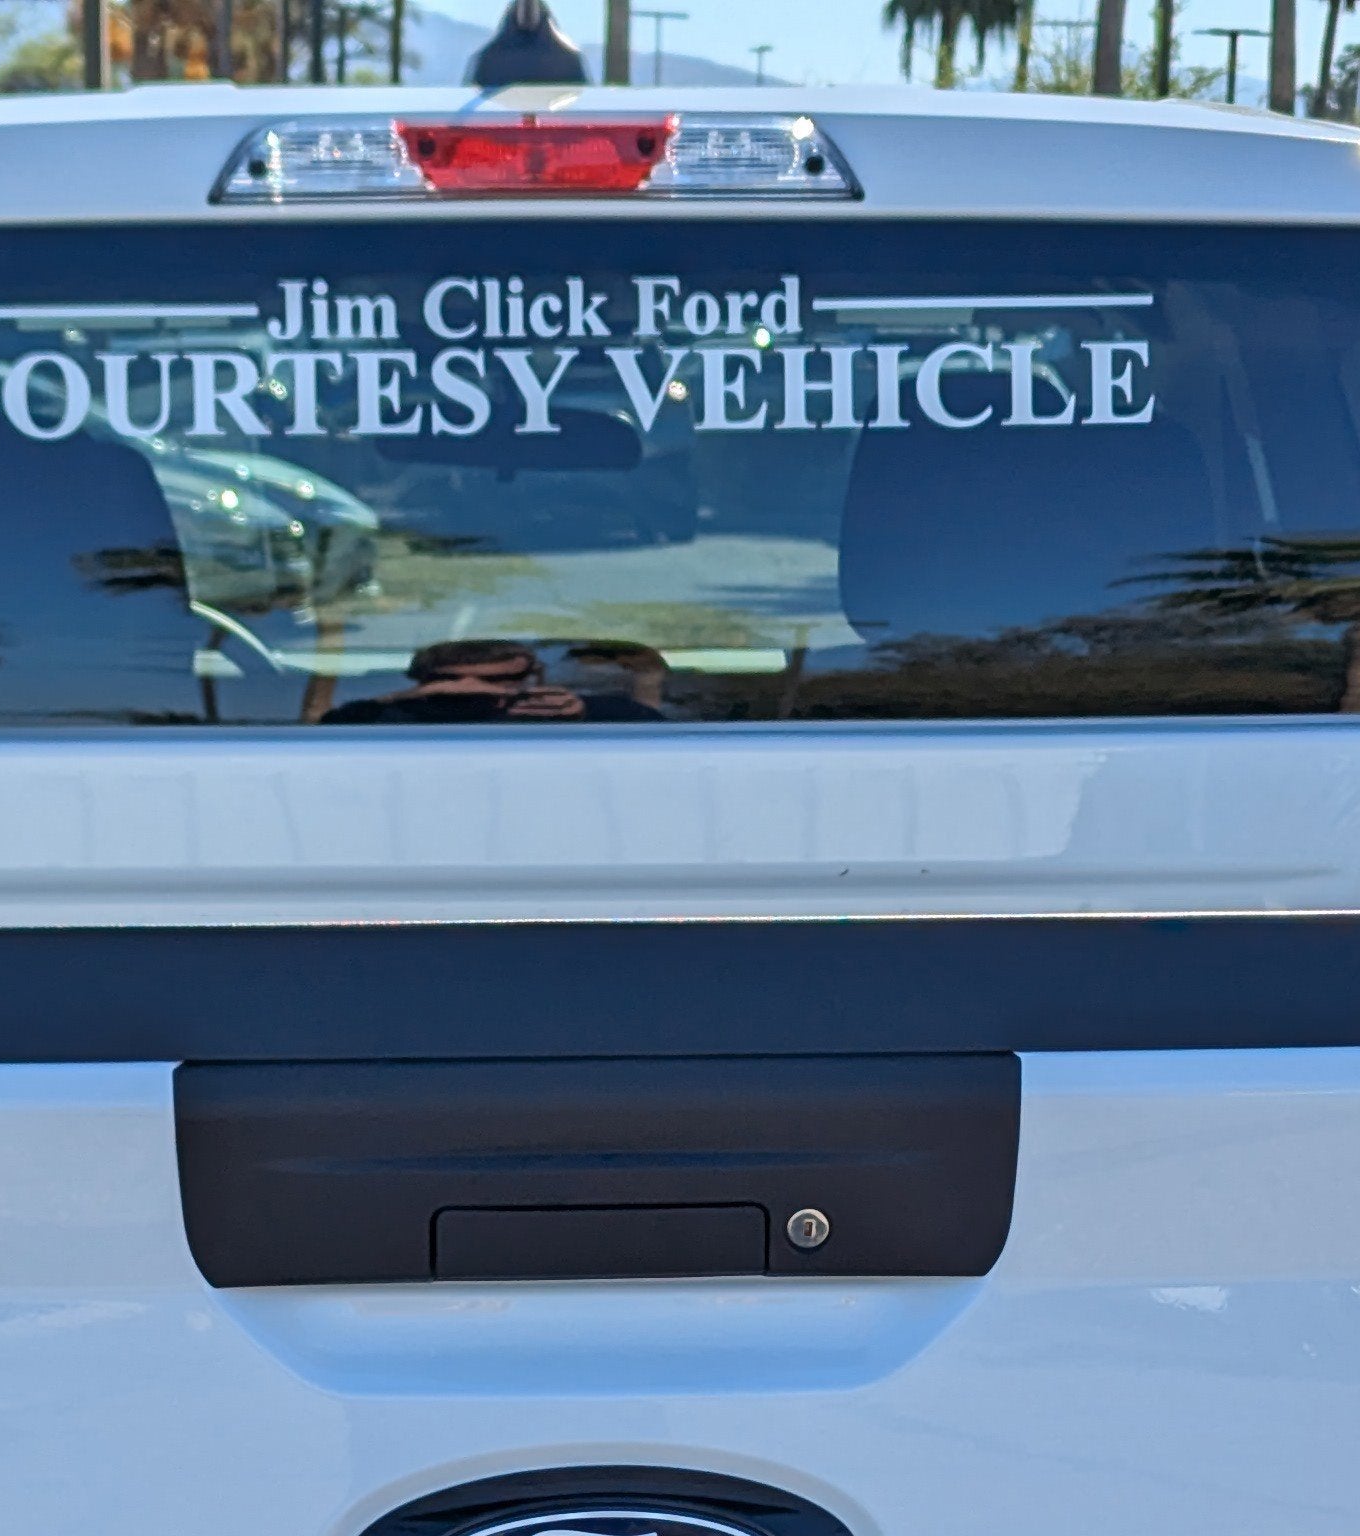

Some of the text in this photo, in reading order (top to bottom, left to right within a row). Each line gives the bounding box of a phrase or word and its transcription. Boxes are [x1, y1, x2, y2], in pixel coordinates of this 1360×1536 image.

[267, 274, 802, 340] Jim Click Ford
[605, 339, 1156, 434] VEHICLE
